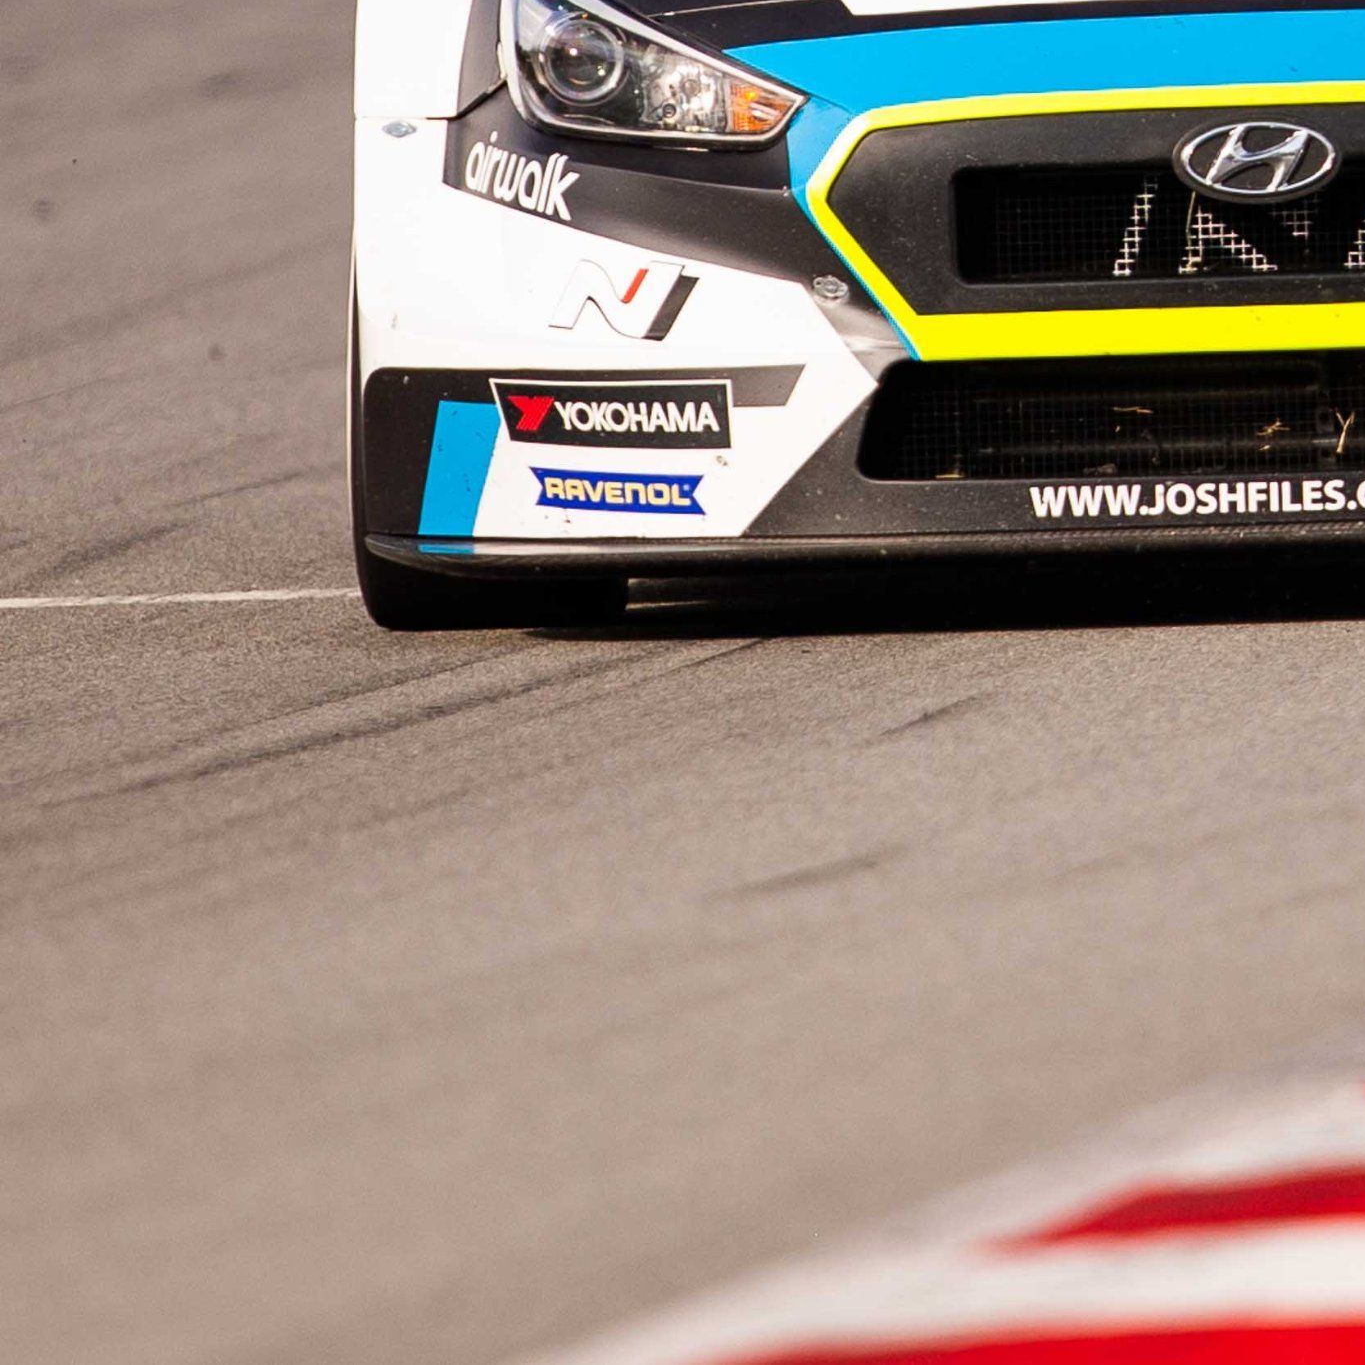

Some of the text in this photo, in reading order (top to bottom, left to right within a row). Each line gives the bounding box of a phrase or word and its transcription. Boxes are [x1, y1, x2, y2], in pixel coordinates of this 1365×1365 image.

[465, 131, 580, 220] airwalk
[554, 401, 721, 433] YOKOHAMA
[542, 476, 692, 506] RAVENOL
